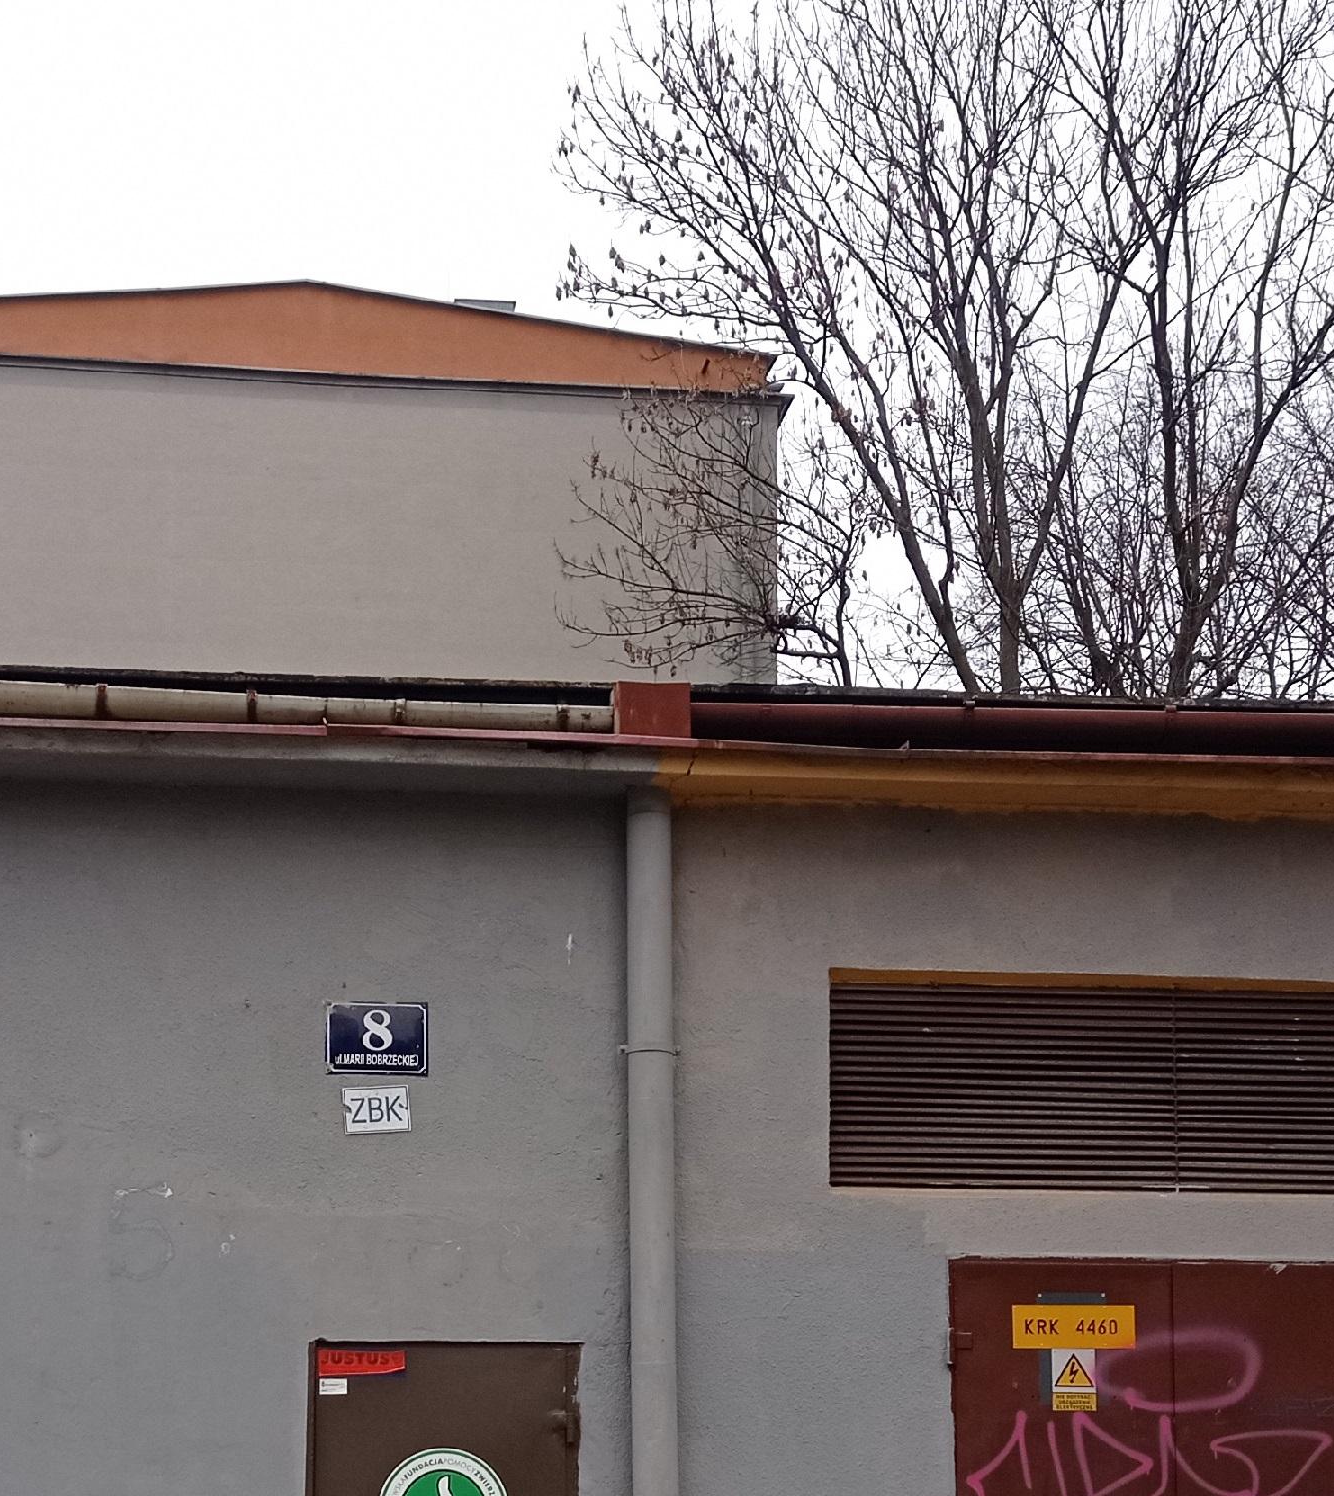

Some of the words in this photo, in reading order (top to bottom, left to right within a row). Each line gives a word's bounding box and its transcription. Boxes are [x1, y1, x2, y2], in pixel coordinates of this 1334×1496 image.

[362, 1009, 393, 1051] 8
[366, 1053, 419, 1066] BOBRZECKIEJ
[350, 1095, 403, 1124] ZBK
[1024, 1319, 1059, 1335] KRK
[1076, 1319, 1119, 1335] 4460
[320, 1351, 390, 1365] JUSTUS
